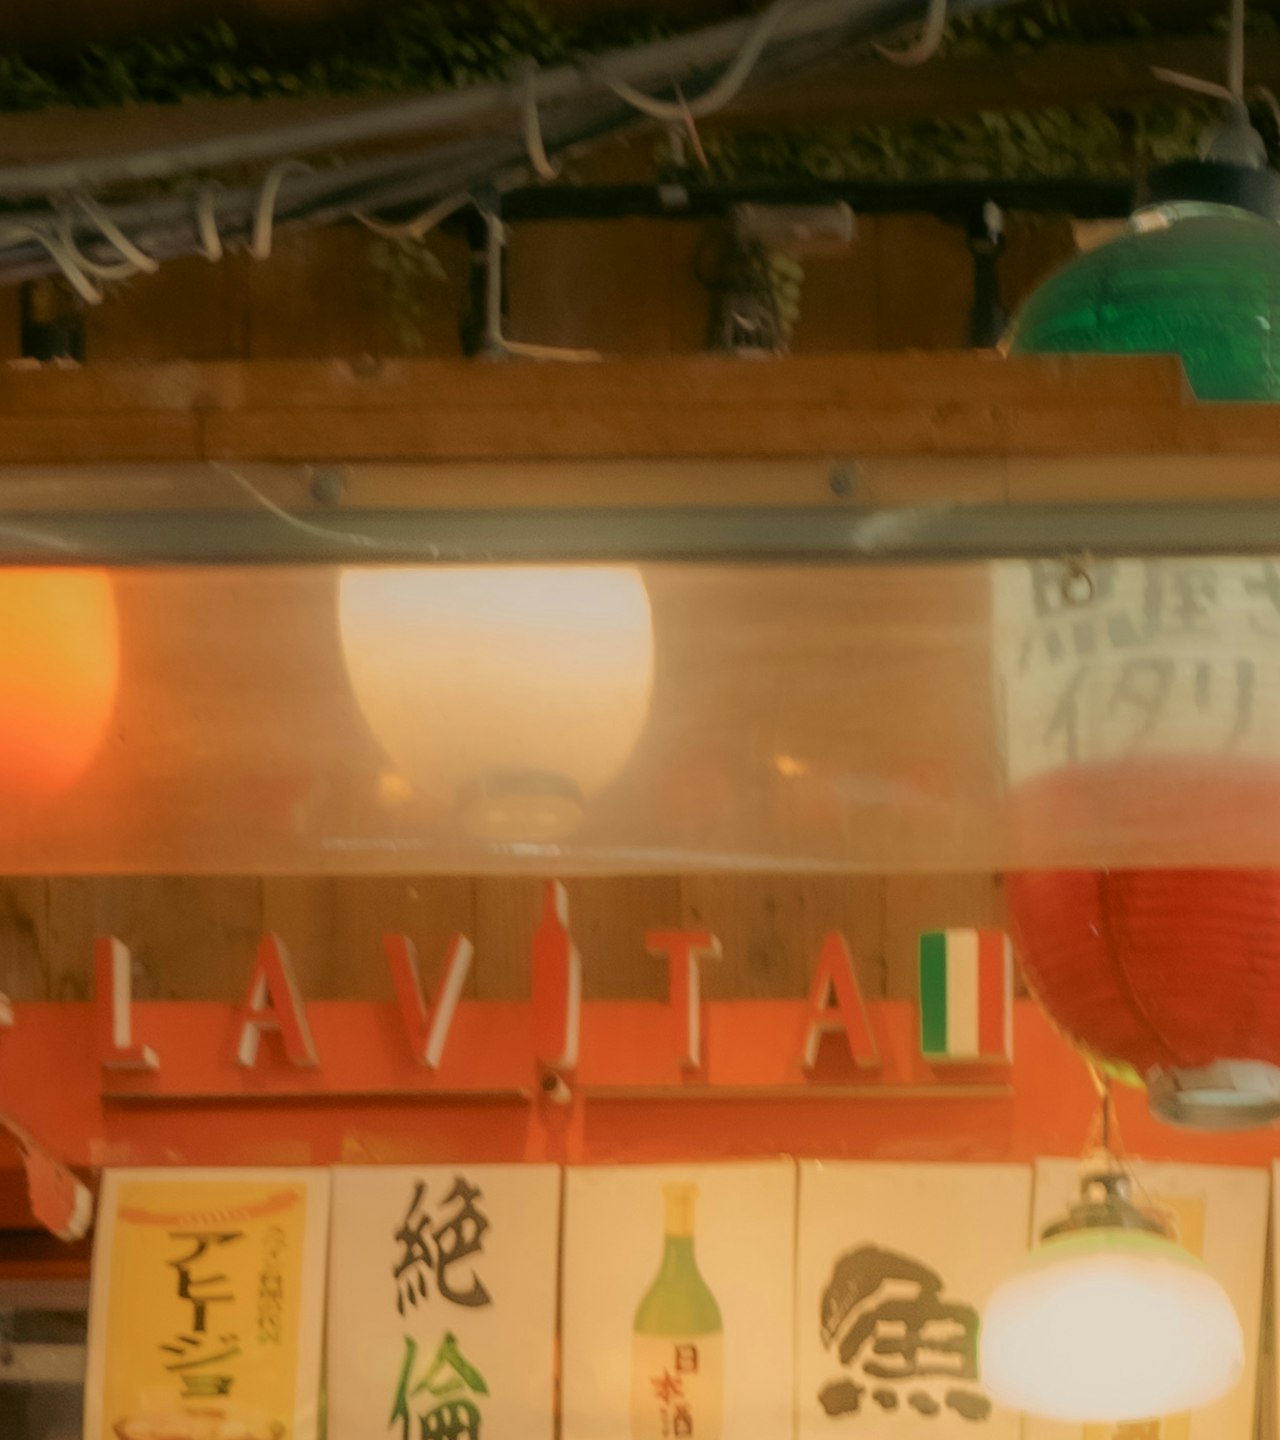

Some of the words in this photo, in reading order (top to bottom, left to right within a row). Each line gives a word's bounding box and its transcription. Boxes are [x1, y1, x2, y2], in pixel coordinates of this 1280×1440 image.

[650, 1343, 700, 1440] 日本酒
[818, 1242, 992, 1422] 魚
